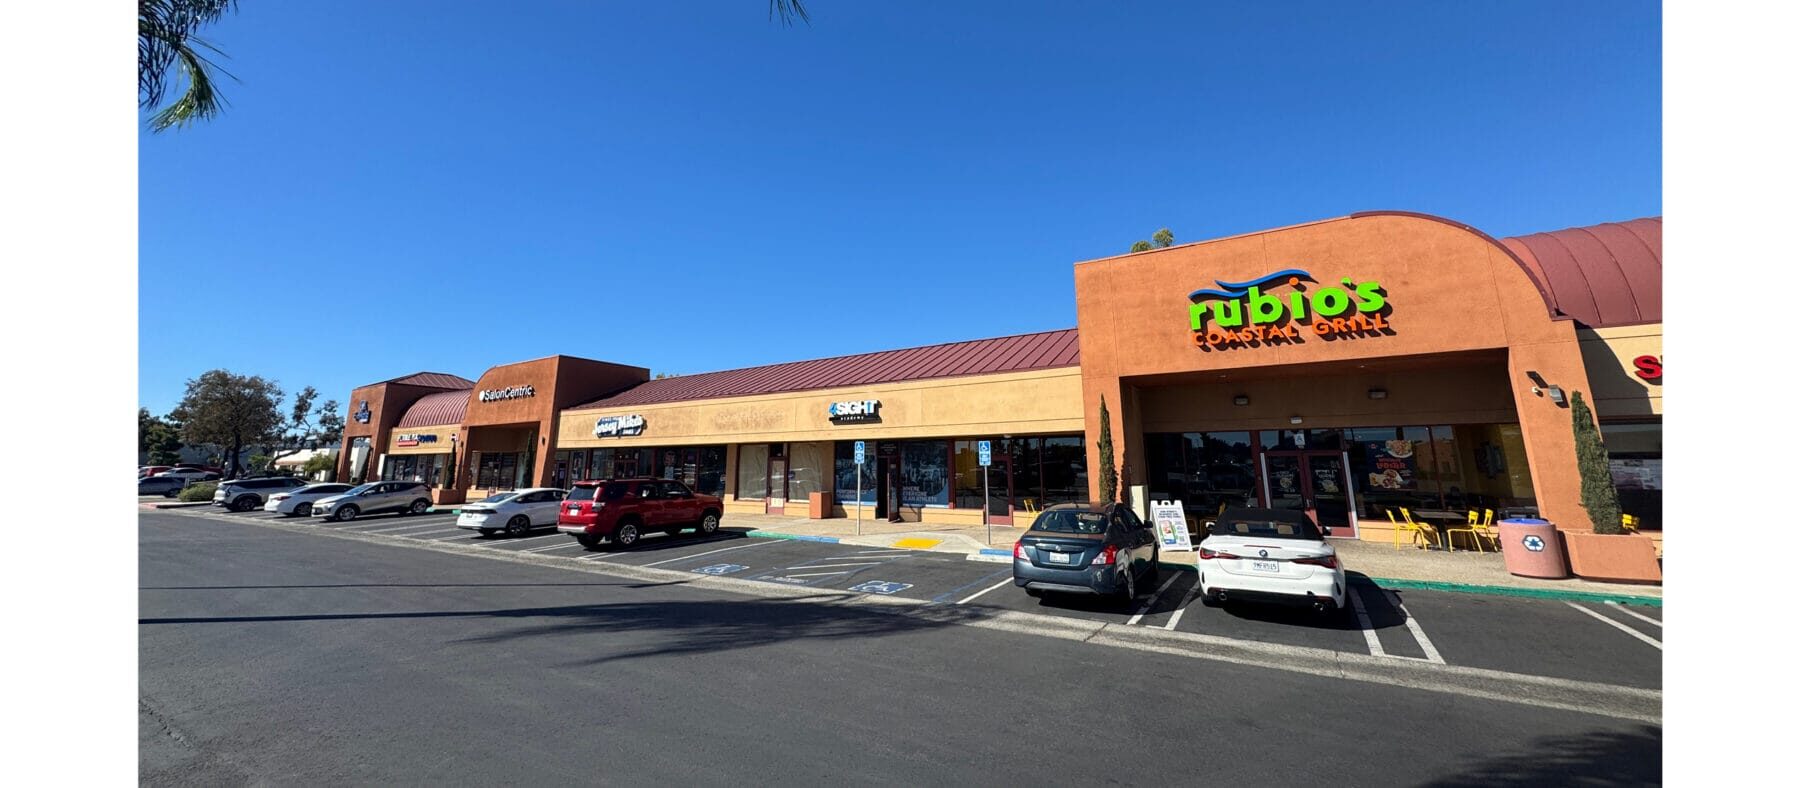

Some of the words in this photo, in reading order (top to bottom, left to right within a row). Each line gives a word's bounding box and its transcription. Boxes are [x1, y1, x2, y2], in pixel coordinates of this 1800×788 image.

[1188, 277, 1385, 330] rubio's
[1192, 323, 1299, 345] COASTAL
[1312, 313, 1389, 335] GRILL
[1633, 355, 1662, 379] S
[484, 386, 533, 400] SalonCentric
[829, 400, 878, 416] 4SIGHT
